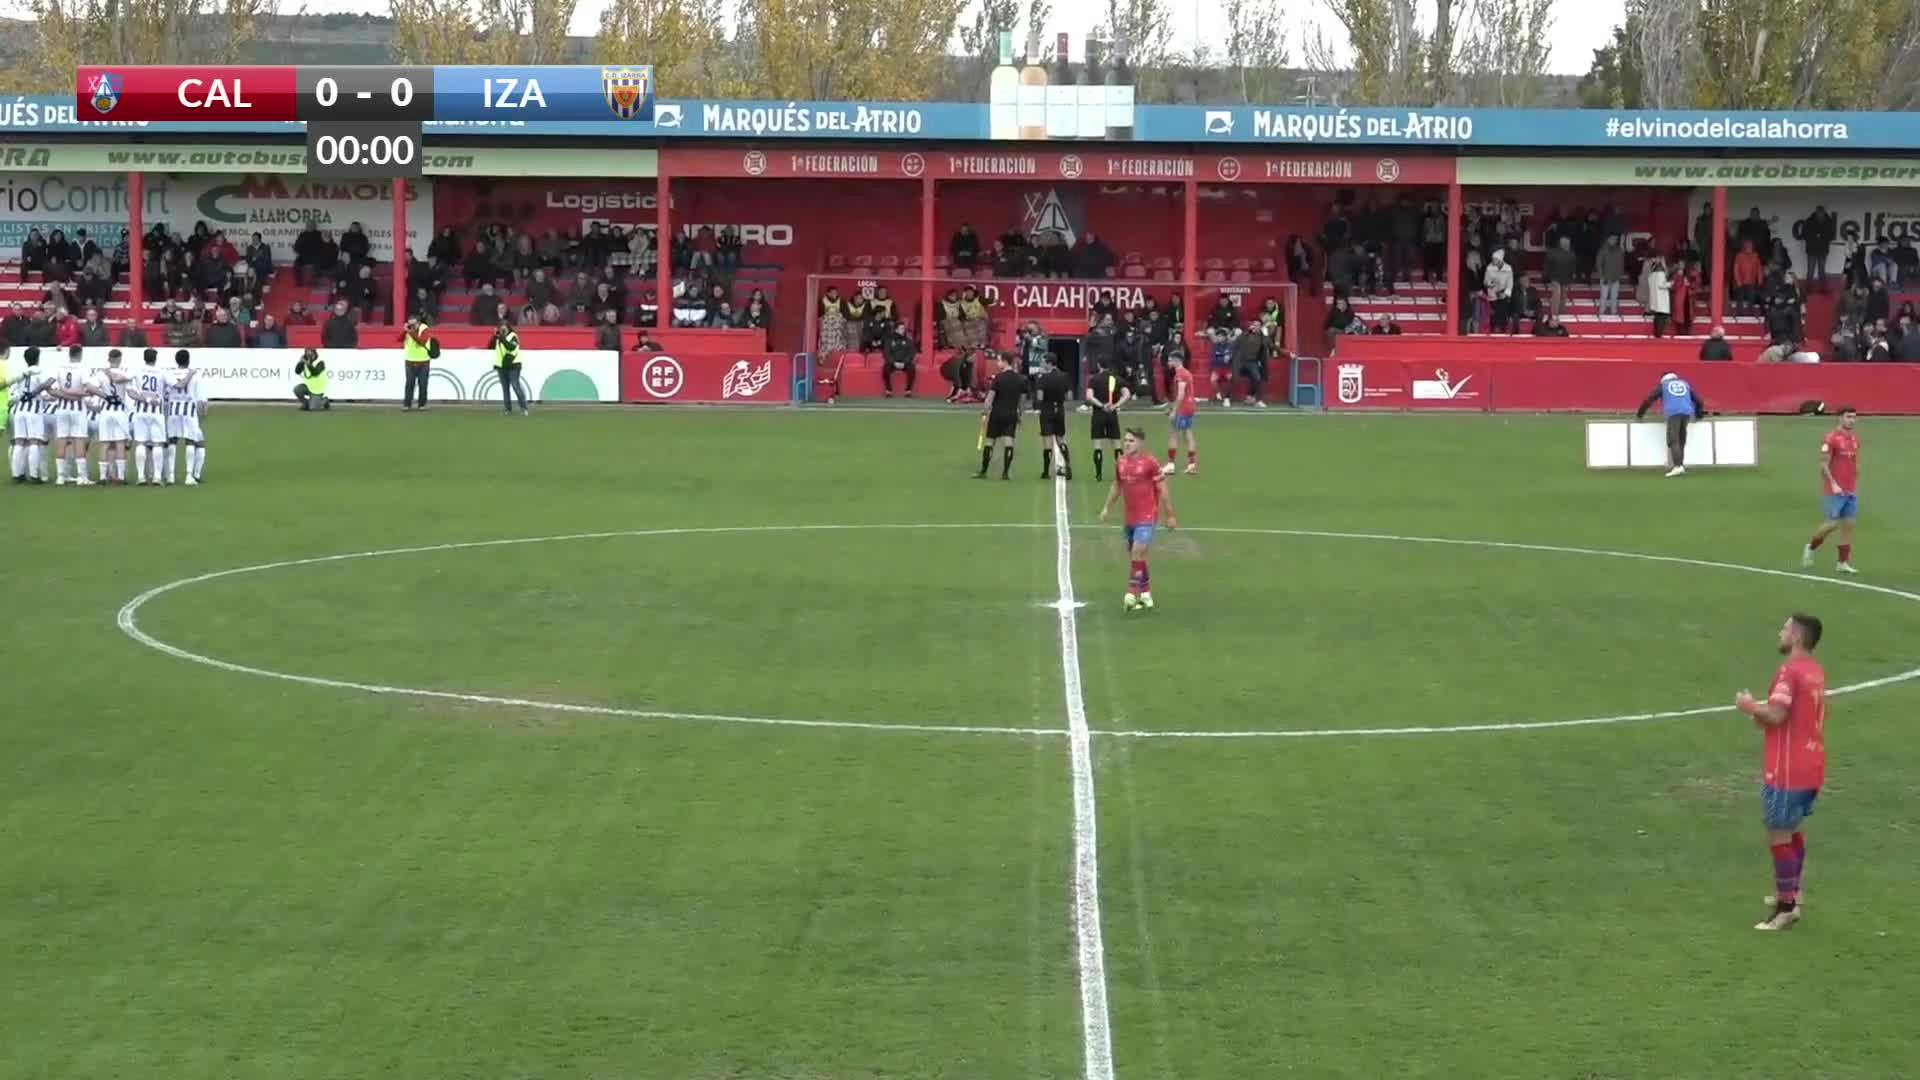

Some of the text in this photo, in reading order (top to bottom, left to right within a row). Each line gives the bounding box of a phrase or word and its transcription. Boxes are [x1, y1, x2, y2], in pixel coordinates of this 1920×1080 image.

[703, 102, 922, 135] MARQUÉS DEL ATRIO
[1253, 108, 1473, 141] MARQUÉS DEL ATRIO
[1605, 117, 1848, 139] #elvinodelcalahorra
[142, 375, 157, 391] 20
